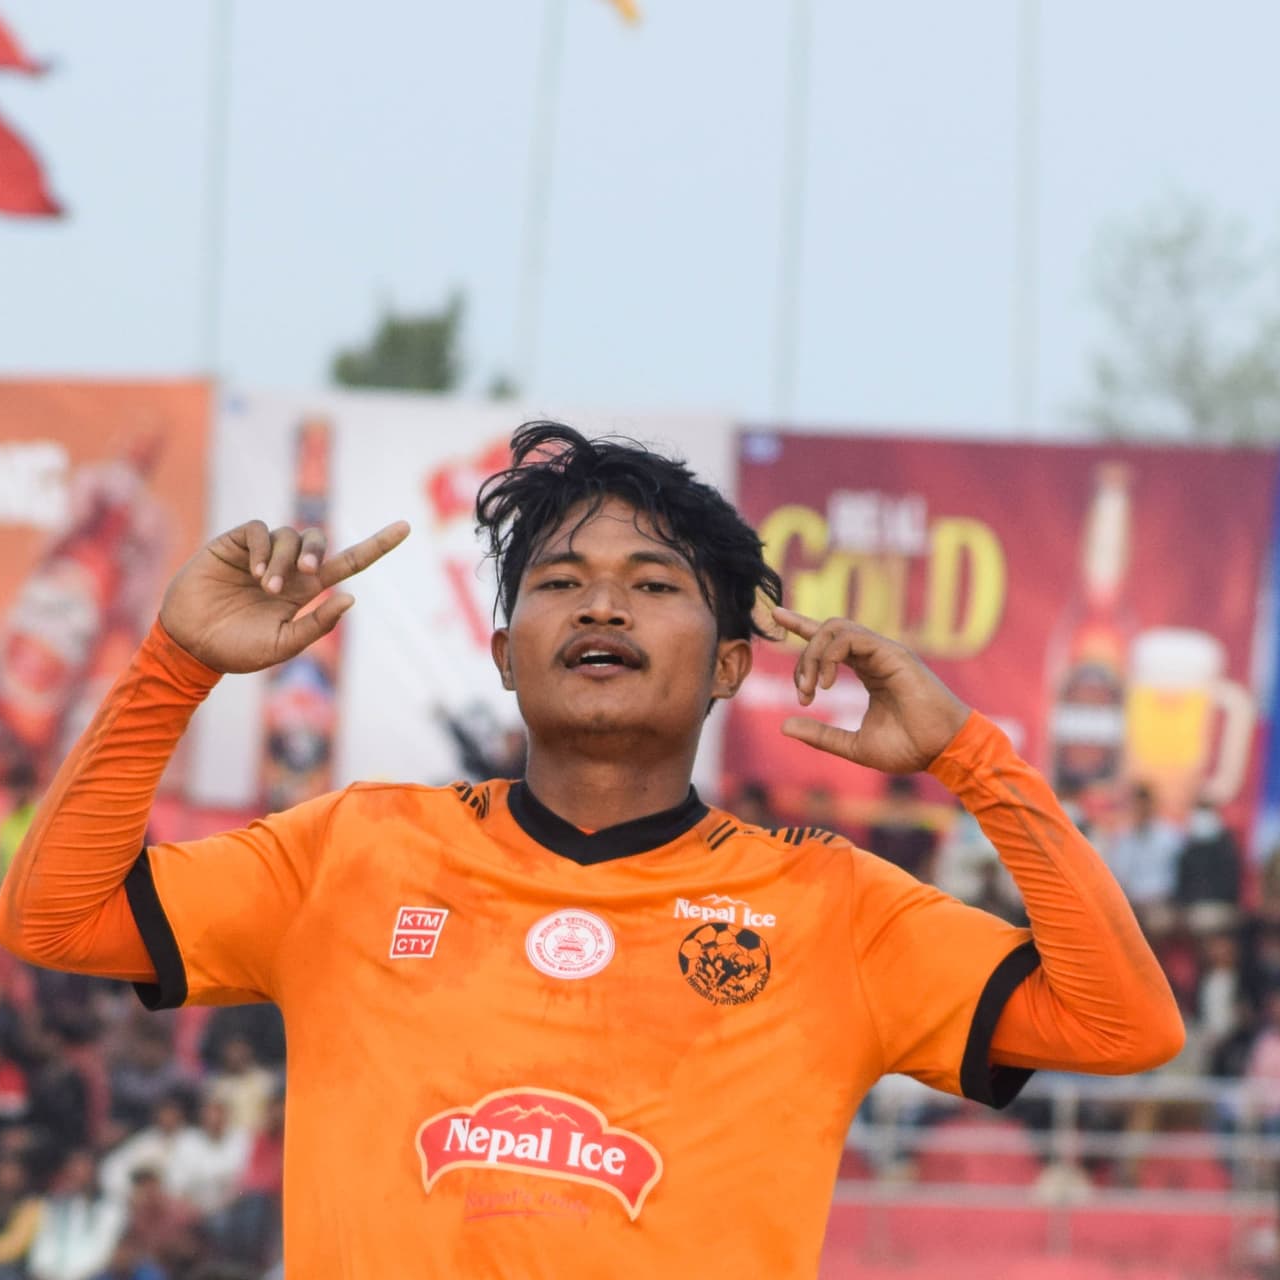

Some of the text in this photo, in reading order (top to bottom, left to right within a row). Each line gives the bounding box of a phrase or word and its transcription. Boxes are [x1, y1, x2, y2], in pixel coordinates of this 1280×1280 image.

[401, 913, 440, 927] KTM
[674, 897, 777, 927] Nepal Ice
[396, 938, 432, 951] CTY
[444, 1118, 626, 1175] Nepal Ice
